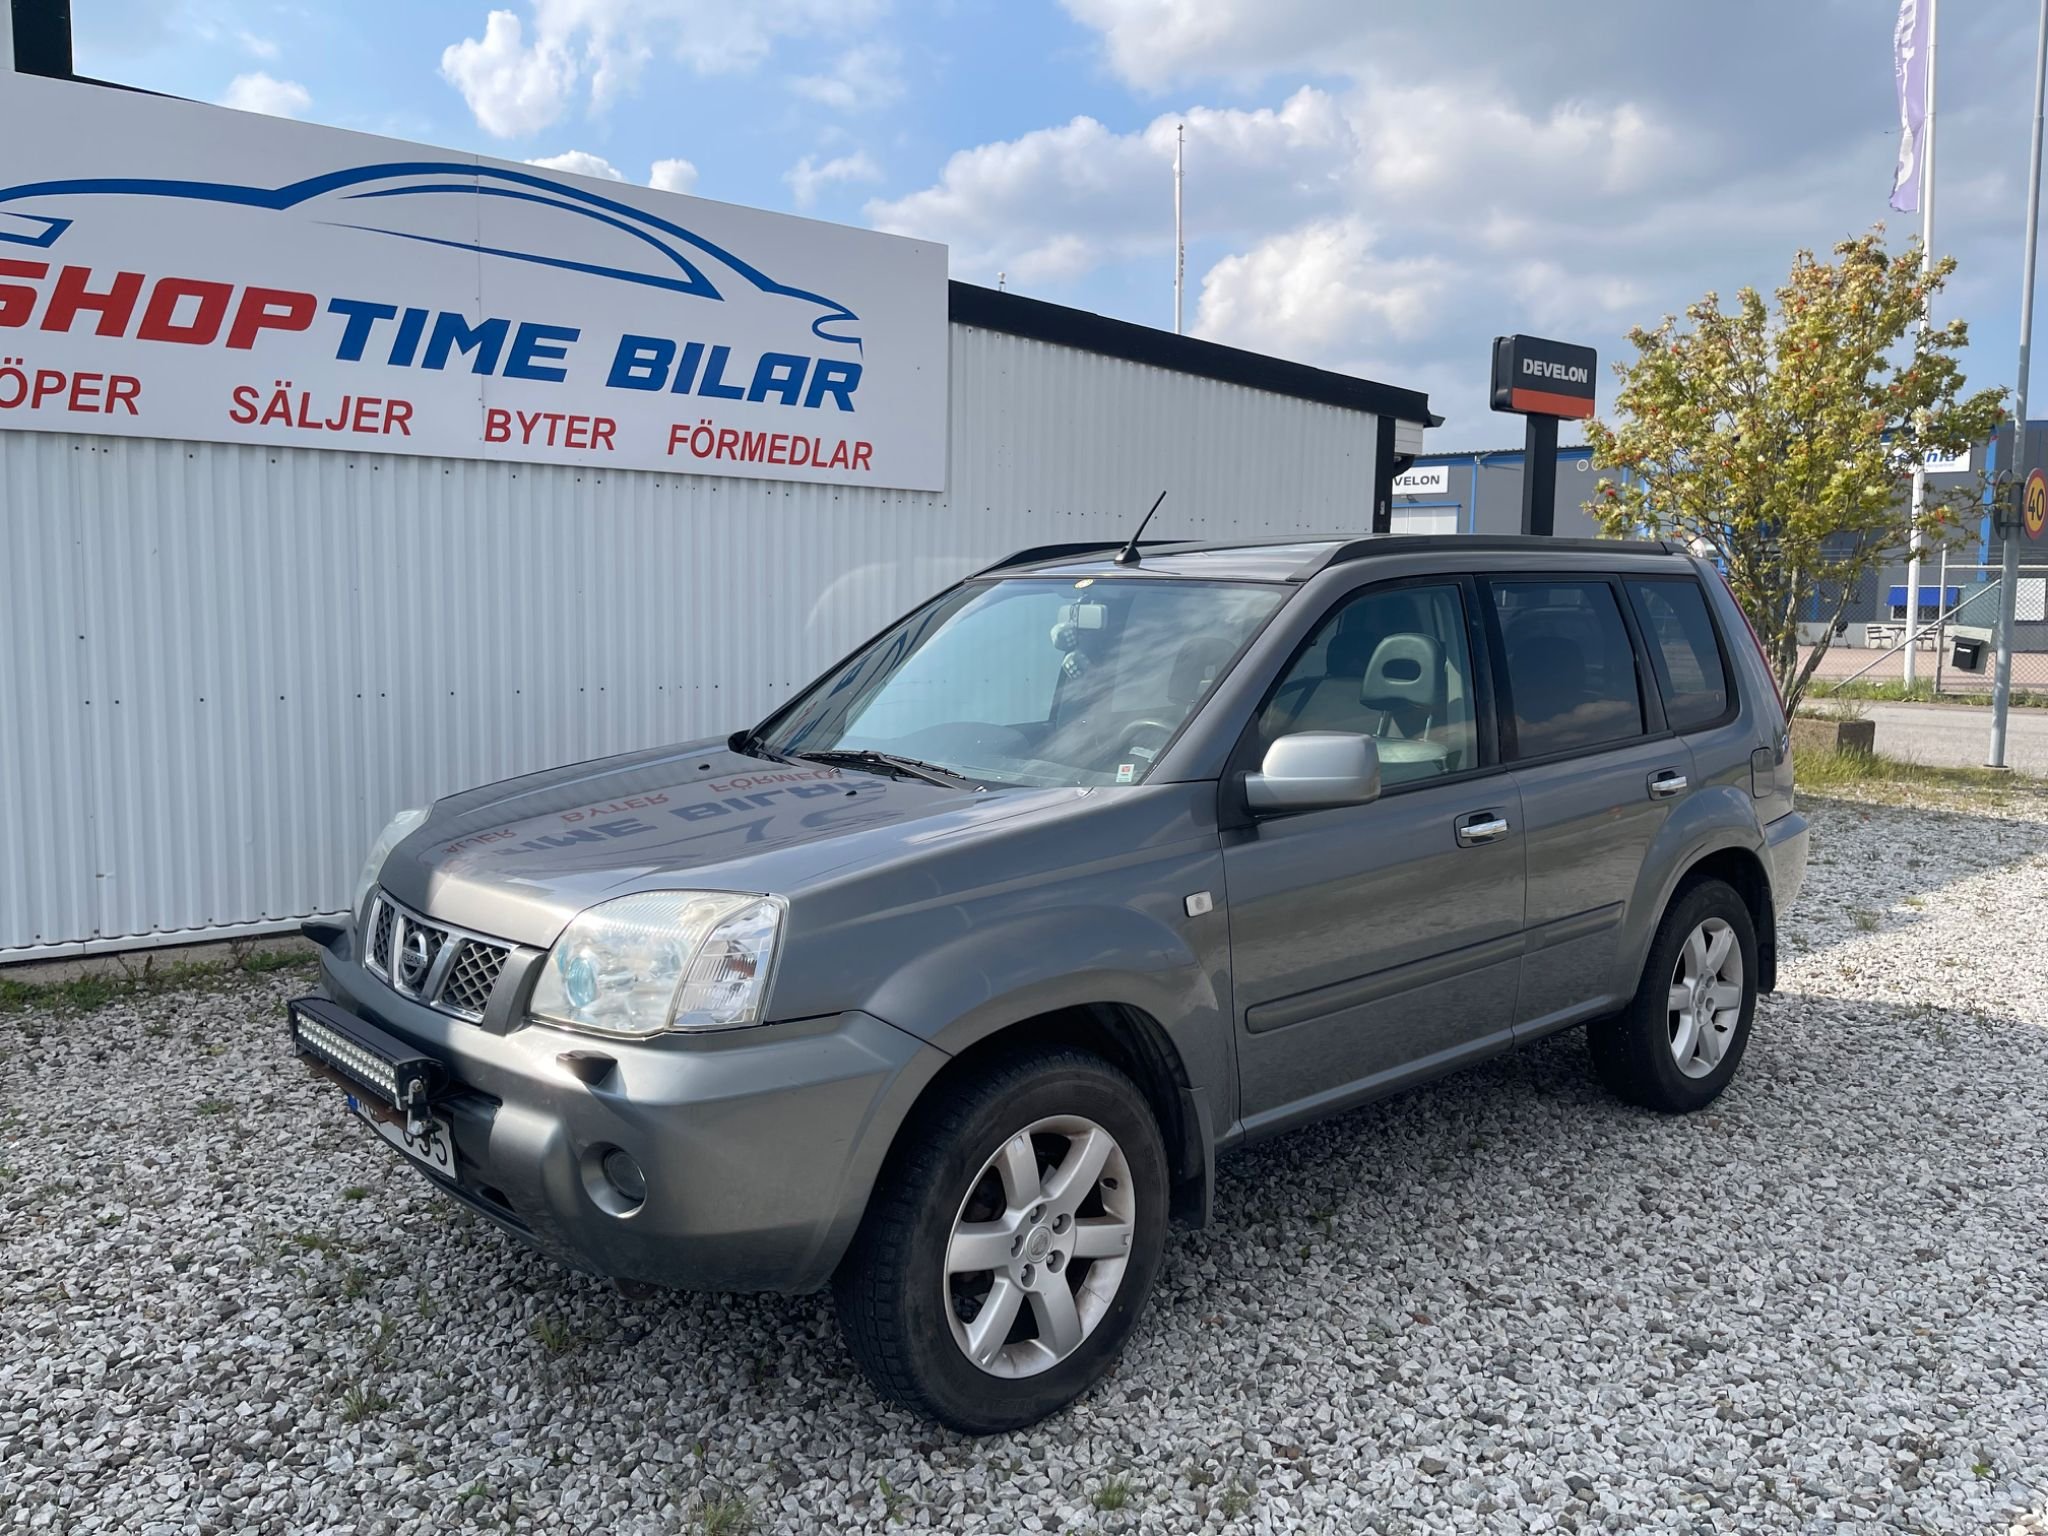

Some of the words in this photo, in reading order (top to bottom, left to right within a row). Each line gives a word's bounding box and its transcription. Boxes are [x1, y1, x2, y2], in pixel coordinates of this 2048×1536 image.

[606, 334, 863, 412] BILAR
[1522, 357, 1588, 384] DEVELON
[229, 379, 413, 436] SÄLJER
[485, 408, 617, 450] BYTER
[667, 418, 873, 471] FÖRMEDLAR
[2028, 487, 2045, 521] 40
